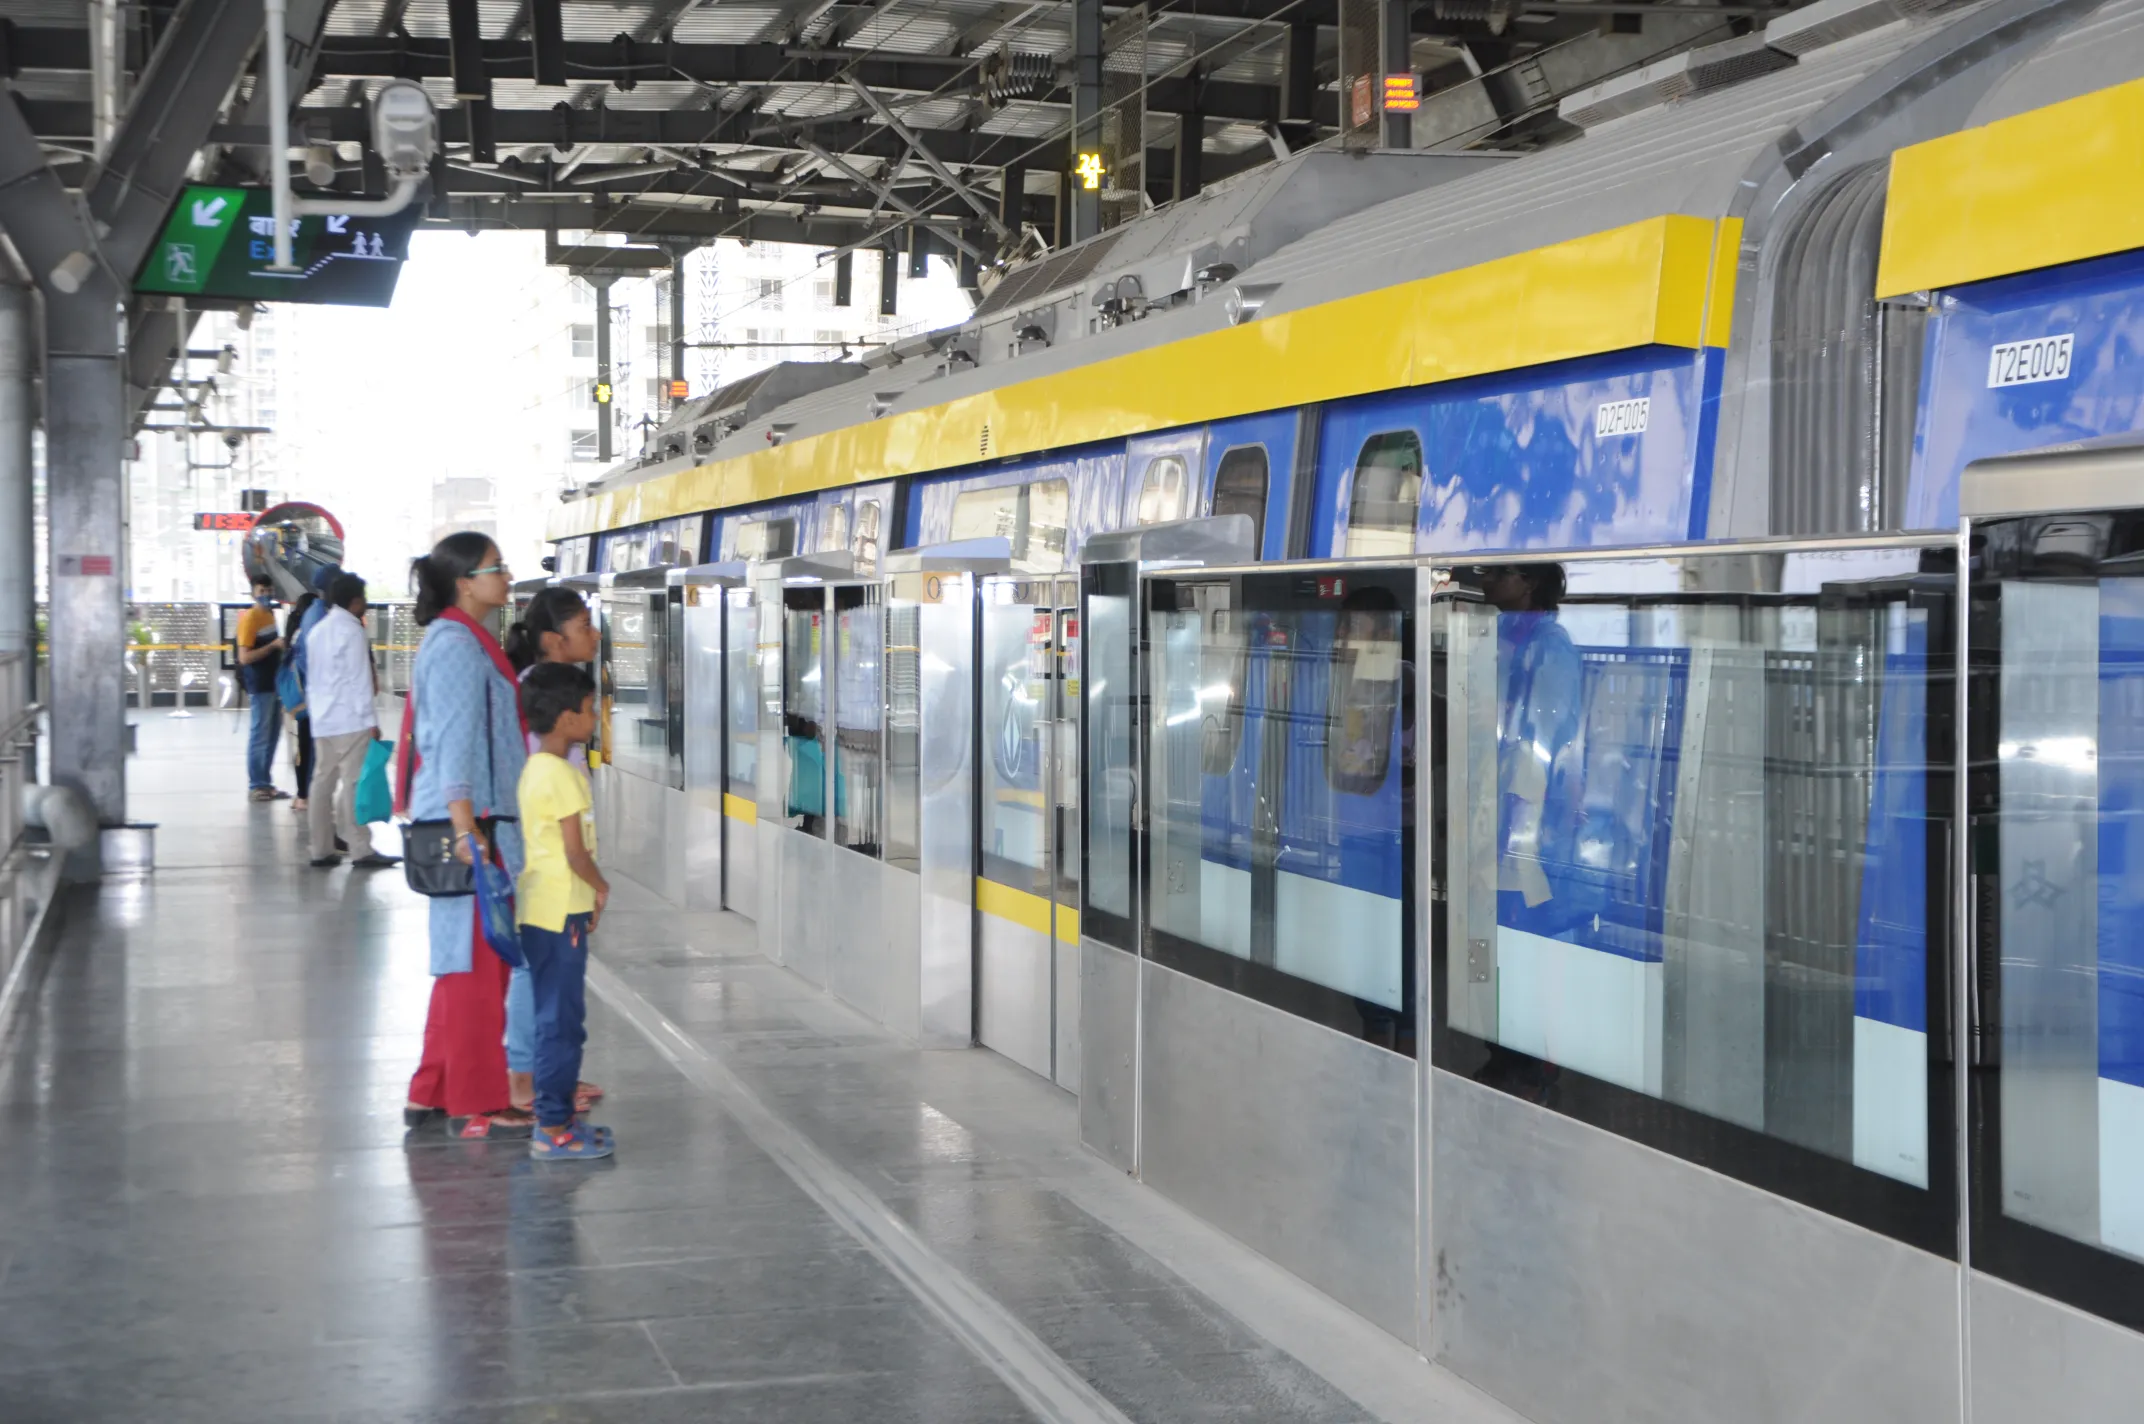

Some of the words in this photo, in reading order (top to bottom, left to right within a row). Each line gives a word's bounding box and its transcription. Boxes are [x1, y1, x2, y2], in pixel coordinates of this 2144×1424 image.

[248, 216, 302, 238] बार
[249, 239, 296, 262] Ex
[1995, 338, 2070, 384] T2E005
[1599, 400, 1648, 434] D2F005
